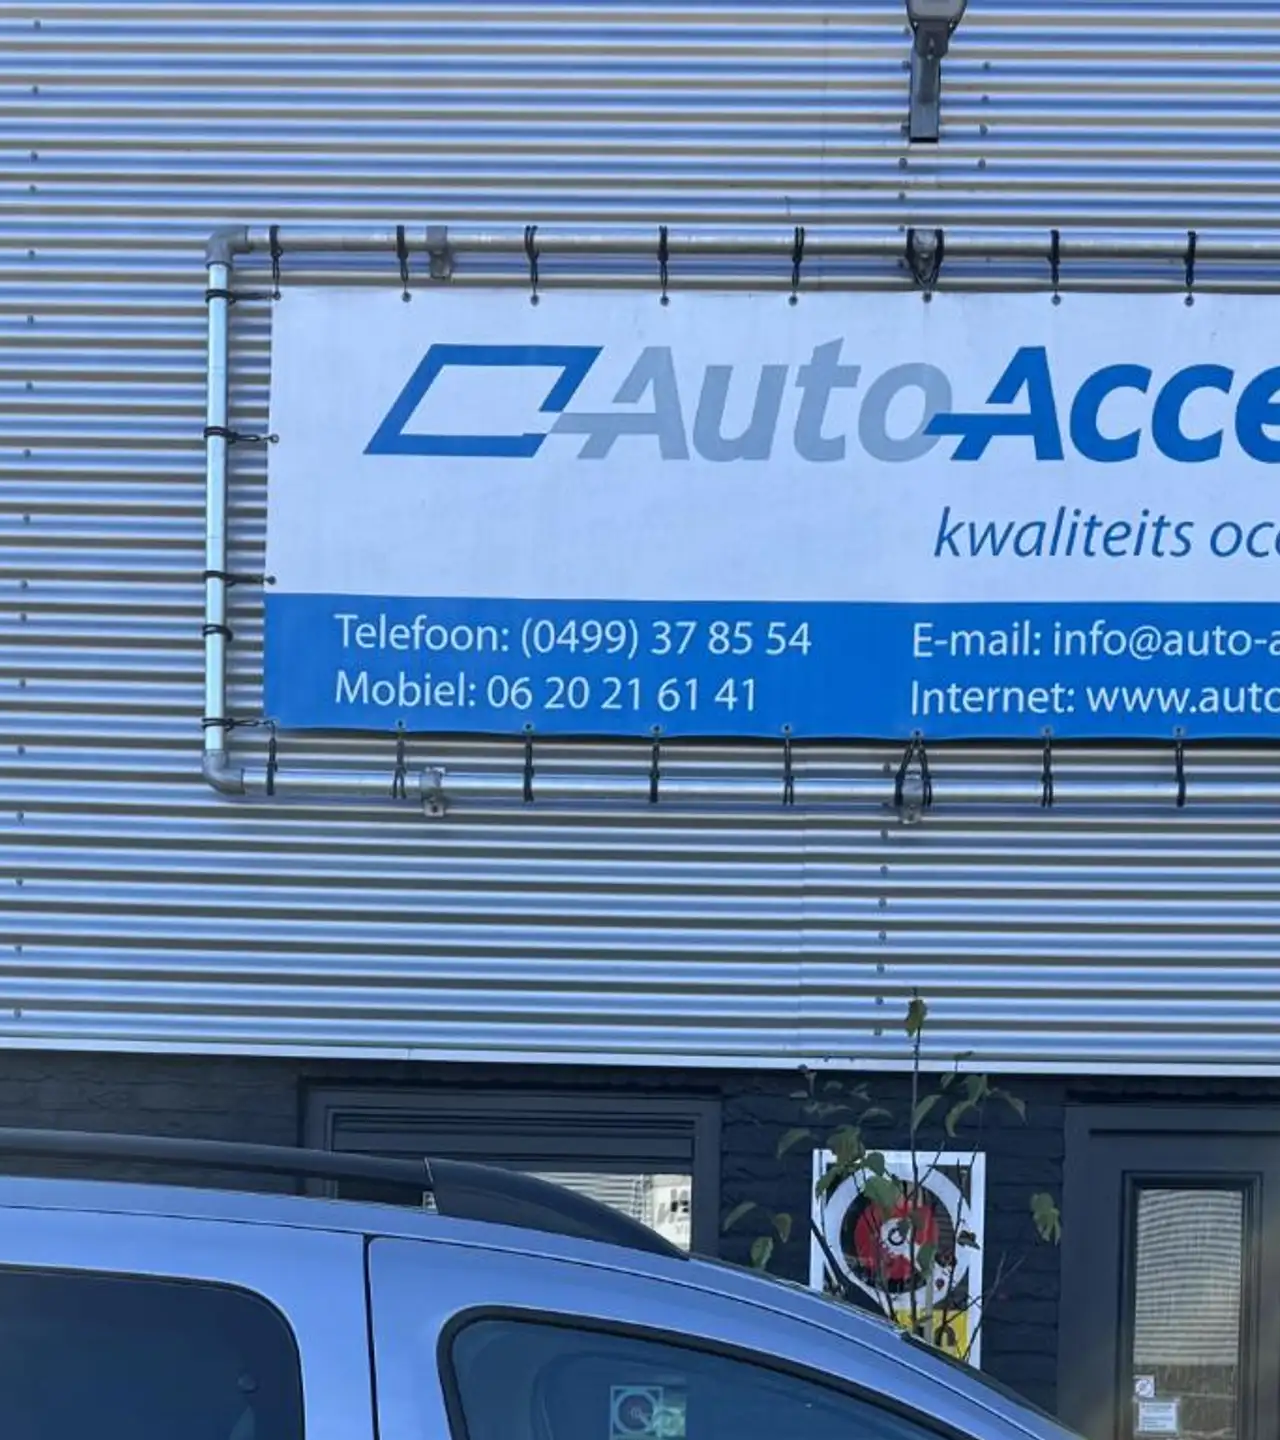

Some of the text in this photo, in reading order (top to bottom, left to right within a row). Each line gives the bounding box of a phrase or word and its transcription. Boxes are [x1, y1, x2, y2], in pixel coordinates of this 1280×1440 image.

[933, 505, 1195, 559] kwaliteits
[332, 612, 812, 659] Telefoon: (0499) 37 85 54
[912, 620, 1041, 658] E-mail:
[334, 669, 755, 712] Mobiel: 06 20 21 61 41
[911, 680, 1075, 716] Internet:
